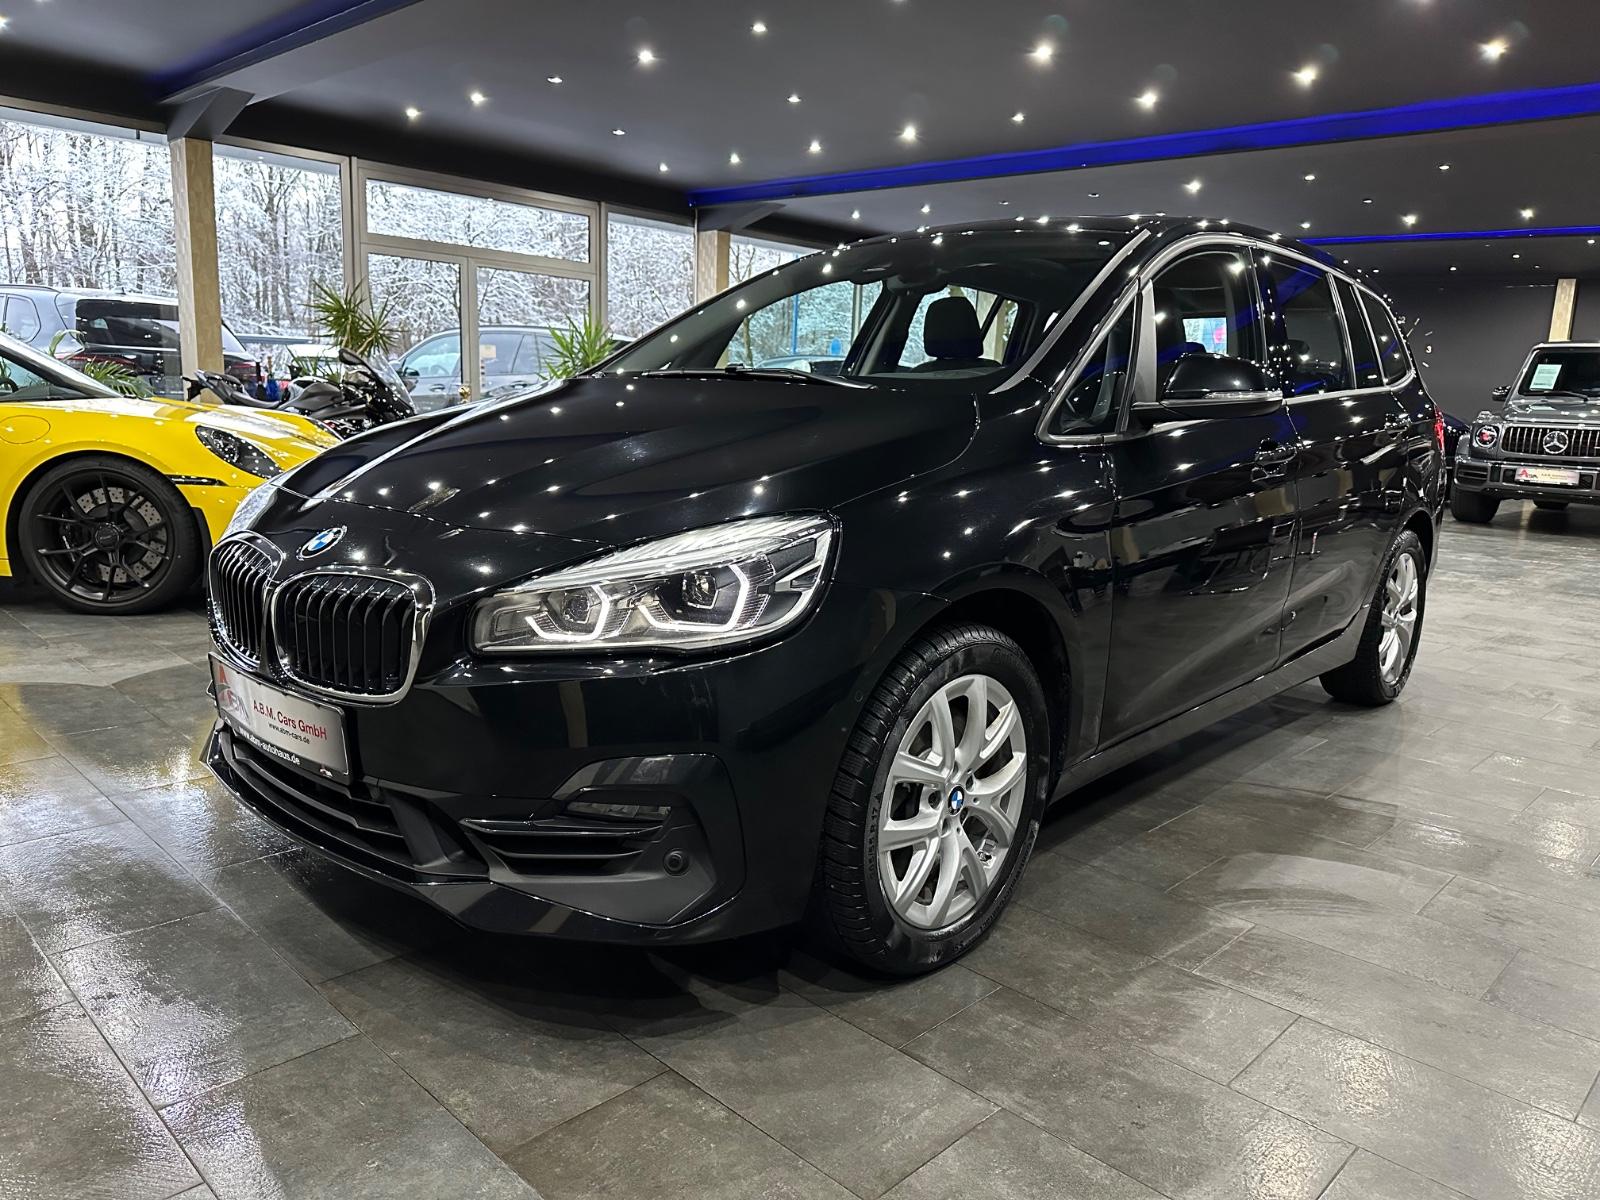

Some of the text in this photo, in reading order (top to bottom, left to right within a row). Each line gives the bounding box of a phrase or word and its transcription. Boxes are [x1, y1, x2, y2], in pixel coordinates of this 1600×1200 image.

[1426, 345, 1432, 353] 3
[253, 700, 327, 740] A.B.M. Cars GmbH
